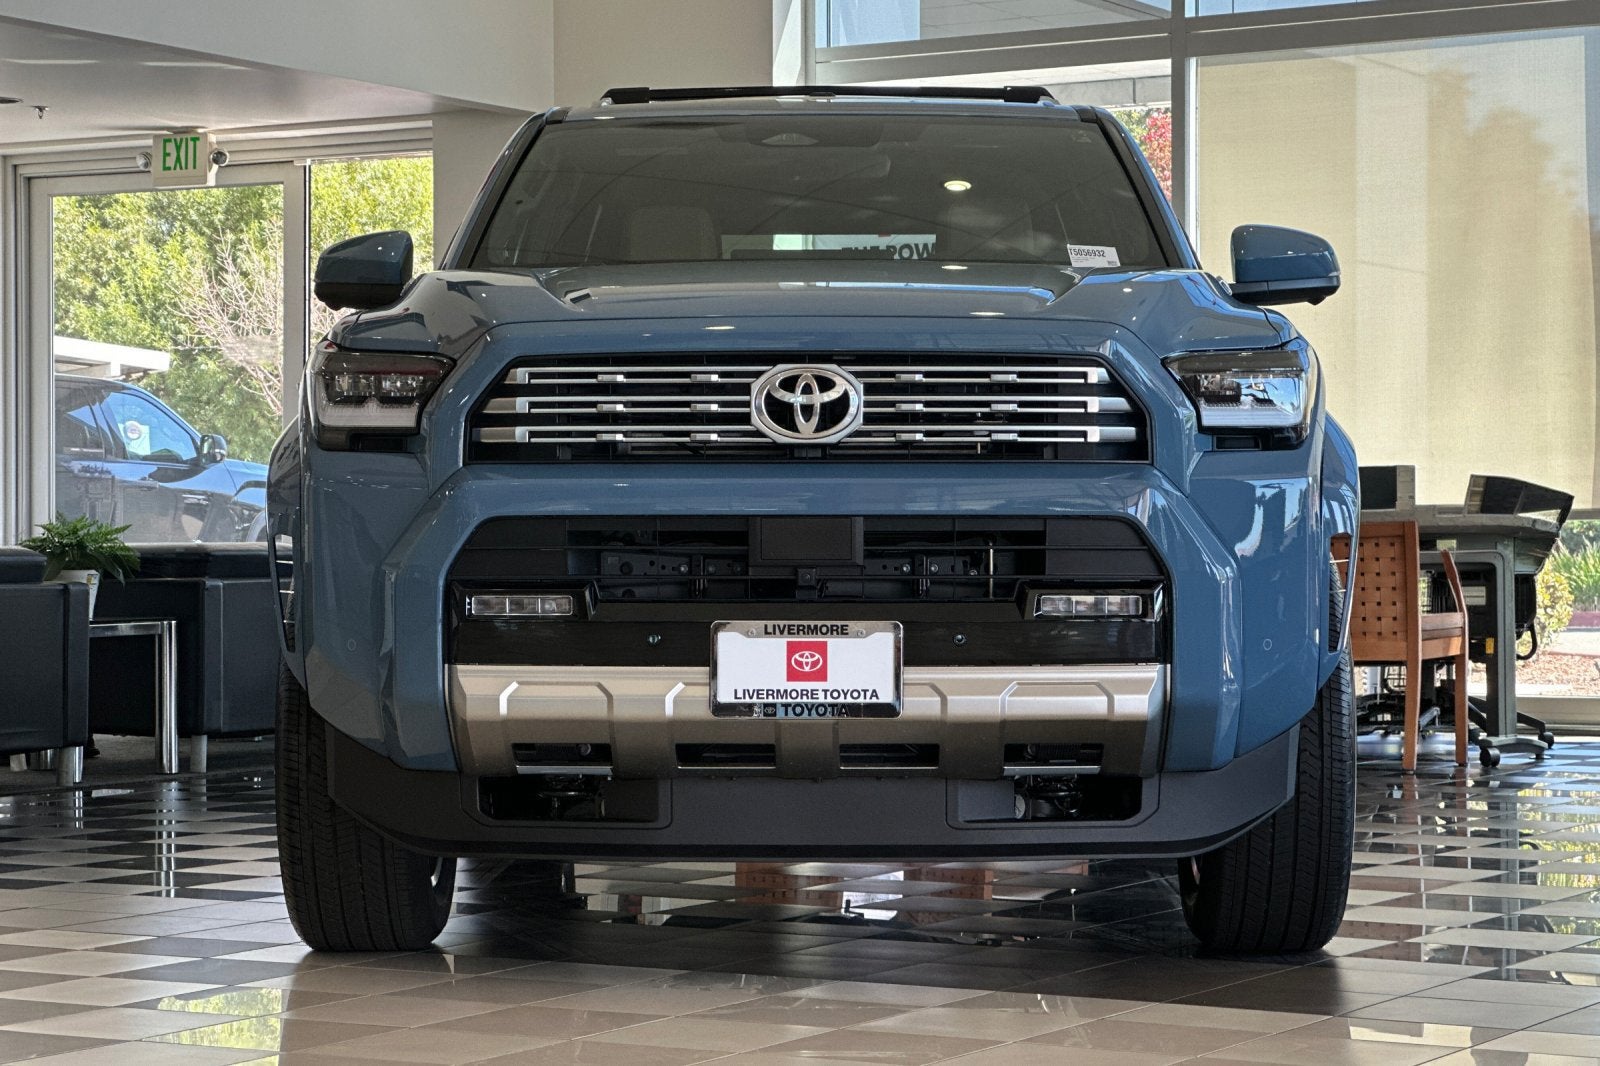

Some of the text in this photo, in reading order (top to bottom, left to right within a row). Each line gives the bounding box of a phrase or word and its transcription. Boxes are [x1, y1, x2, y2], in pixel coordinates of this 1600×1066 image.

[162, 136, 200, 171] EXIT
[763, 623, 849, 636] LIVERMORE
[733, 688, 880, 701] LIVERMORE TOYOTA
[780, 703, 850, 717] TOYOTA
